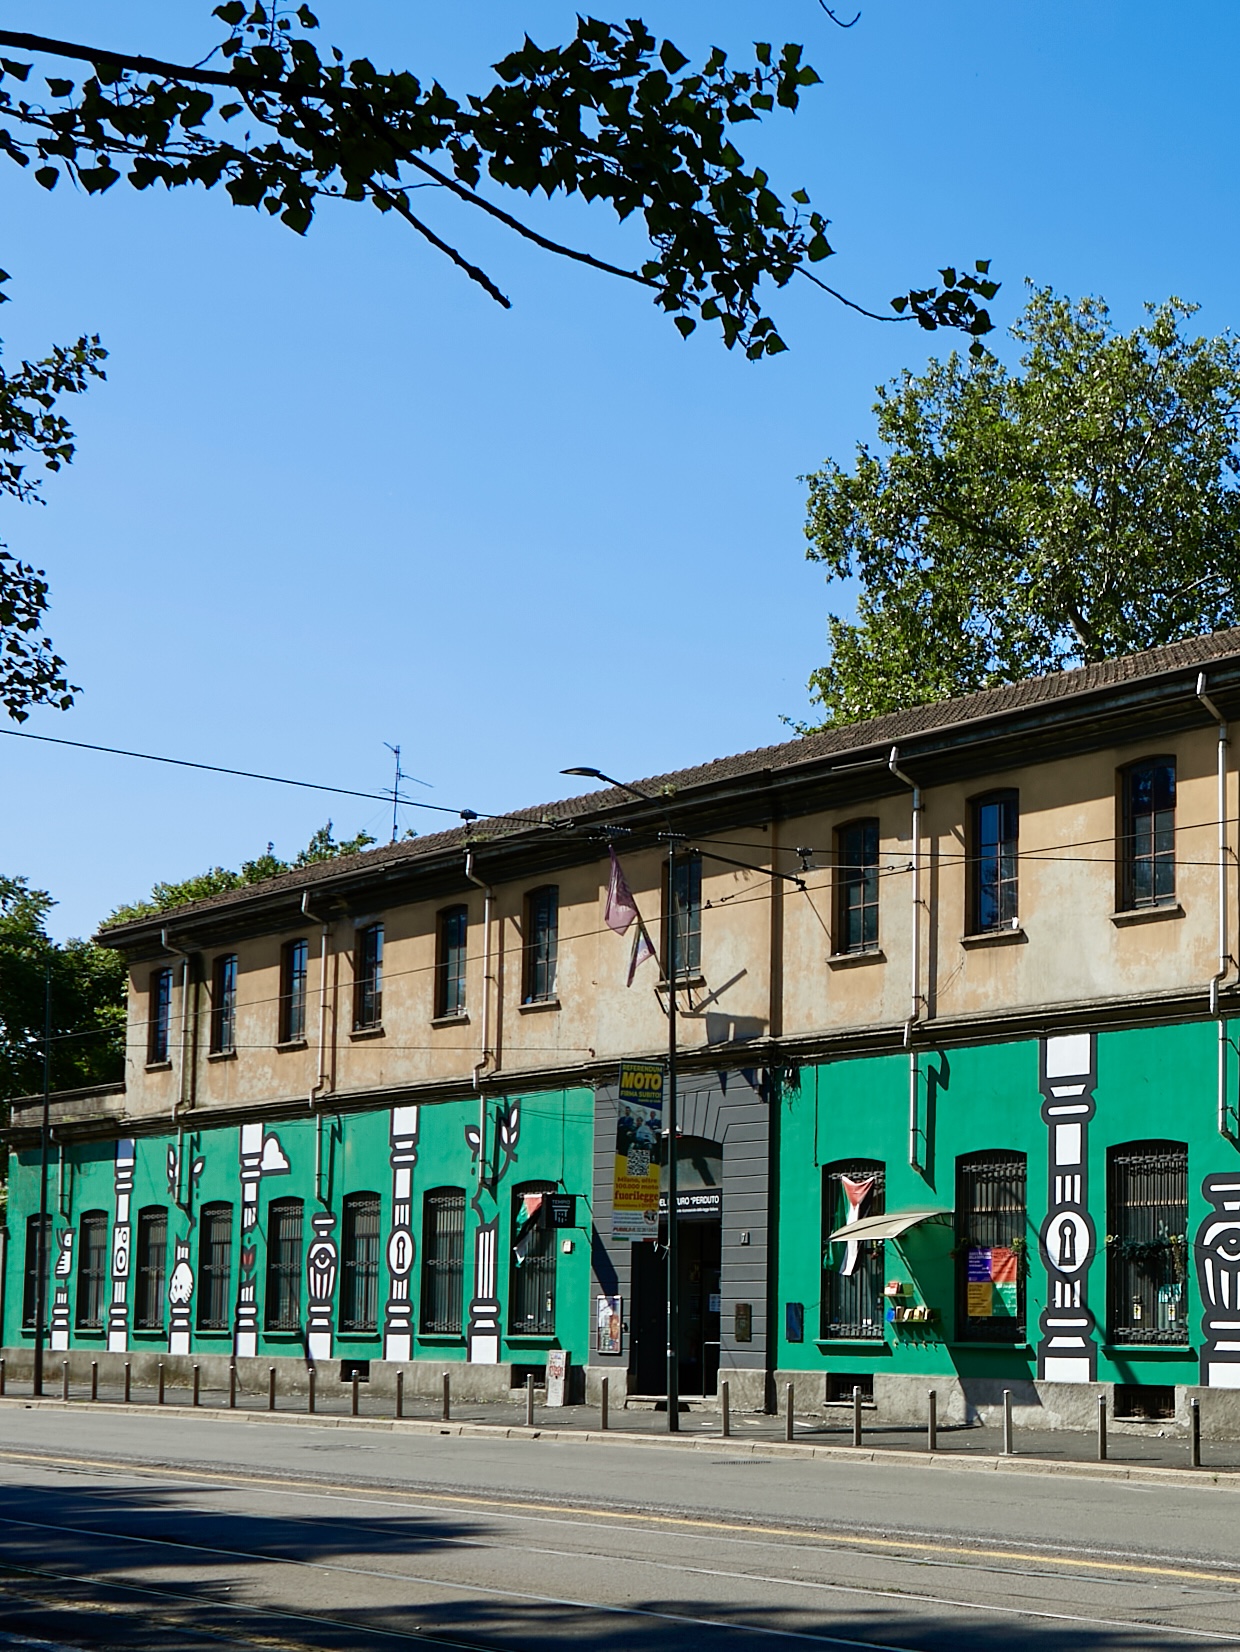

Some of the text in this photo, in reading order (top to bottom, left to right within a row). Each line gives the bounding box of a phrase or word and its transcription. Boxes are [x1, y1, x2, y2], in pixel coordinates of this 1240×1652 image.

[622, 1064, 662, 1072] REFERENDUM
[621, 1071, 662, 1090] MOTO
[615, 1190, 659, 1202] fuorilegge
